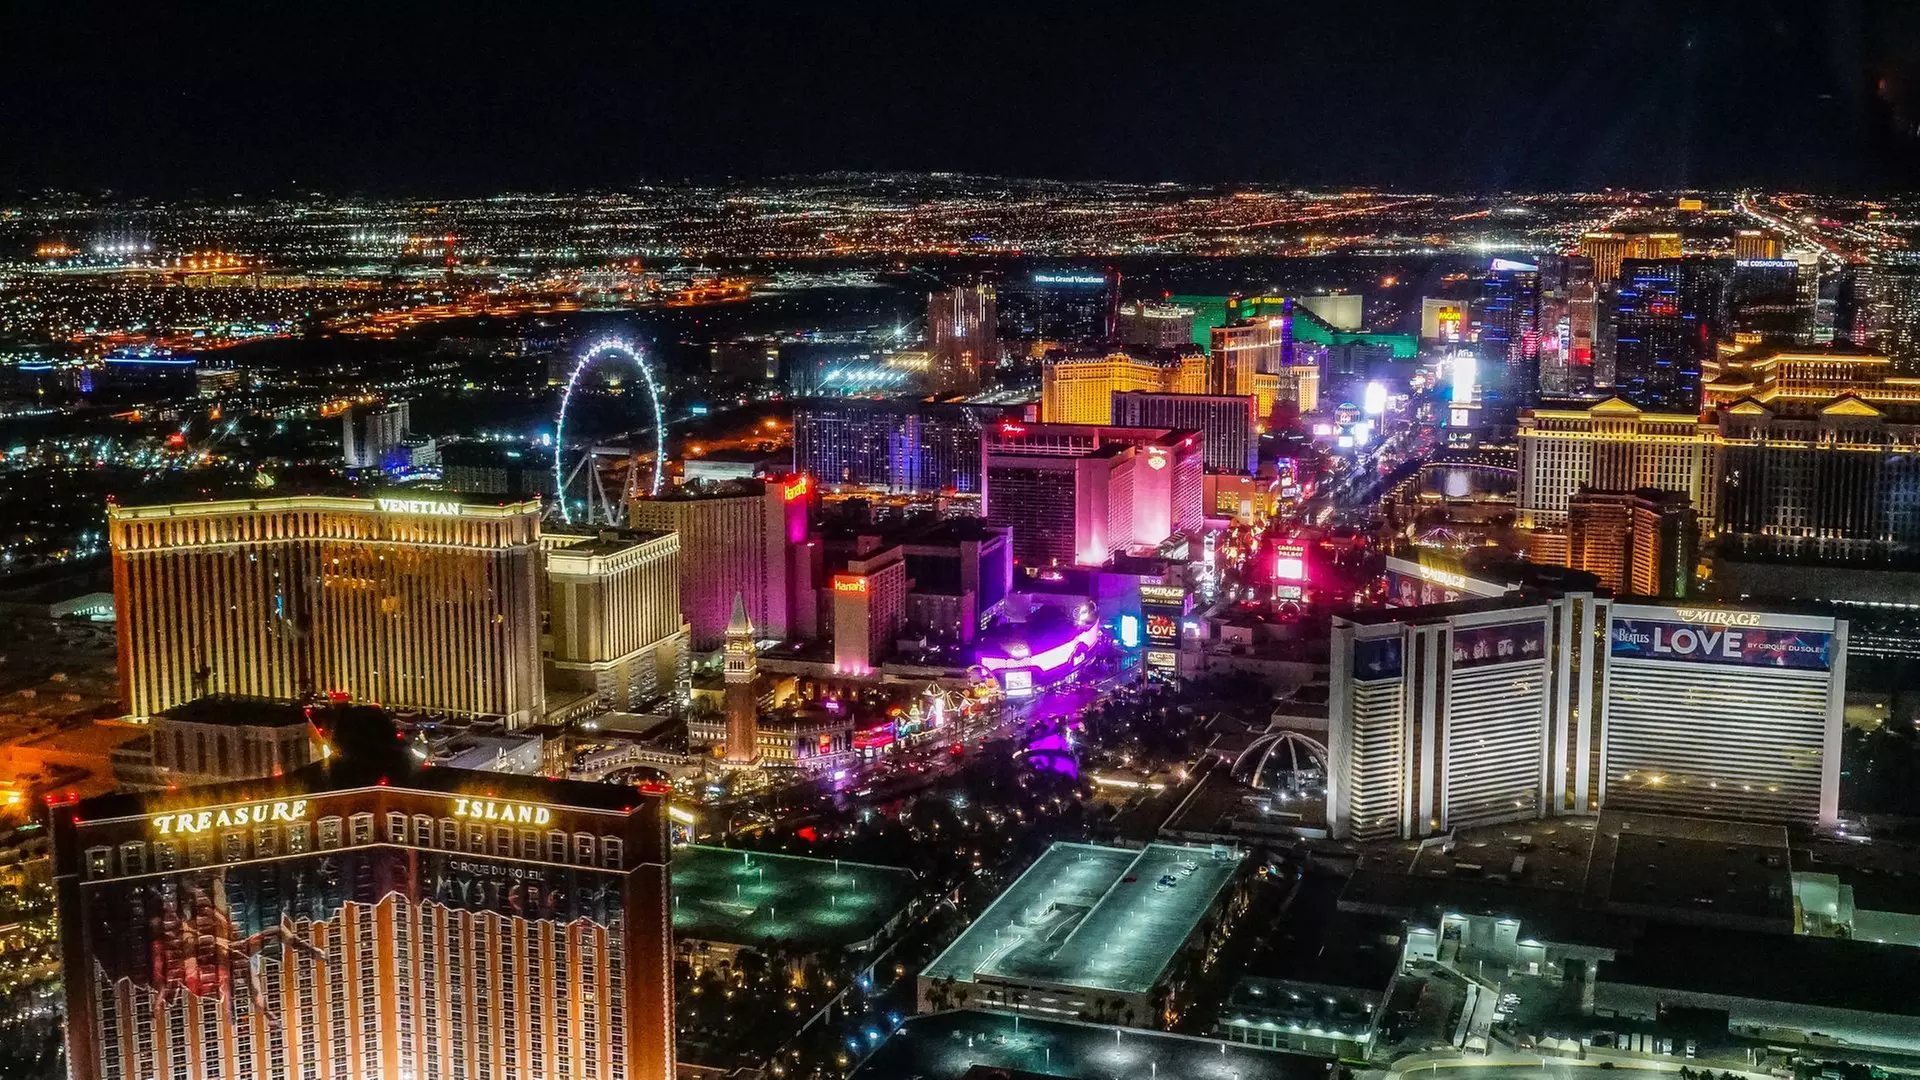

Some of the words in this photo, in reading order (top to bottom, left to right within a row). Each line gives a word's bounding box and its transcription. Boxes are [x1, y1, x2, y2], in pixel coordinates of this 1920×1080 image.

[1055, 275, 1074, 283] Grand
[1439, 312, 1461, 320] MGM
[377, 498, 461, 516] VENETIAN
[1142, 586, 1185, 598] MIRAGE
[1677, 609, 1695, 617] THE
[1682, 611, 1760, 627] MIRAGE
[1146, 624, 1177, 637] LOVE
[1654, 627, 1743, 658] LOVE
[1758, 643, 1787, 652] CIRQUE
[152, 799, 308, 834] TREASURE
[454, 799, 551, 824] ISLAND
[449, 860, 490, 876] CIRQUE
[492, 864, 507, 876] DU
[508, 866, 546, 882] SOLEIL
